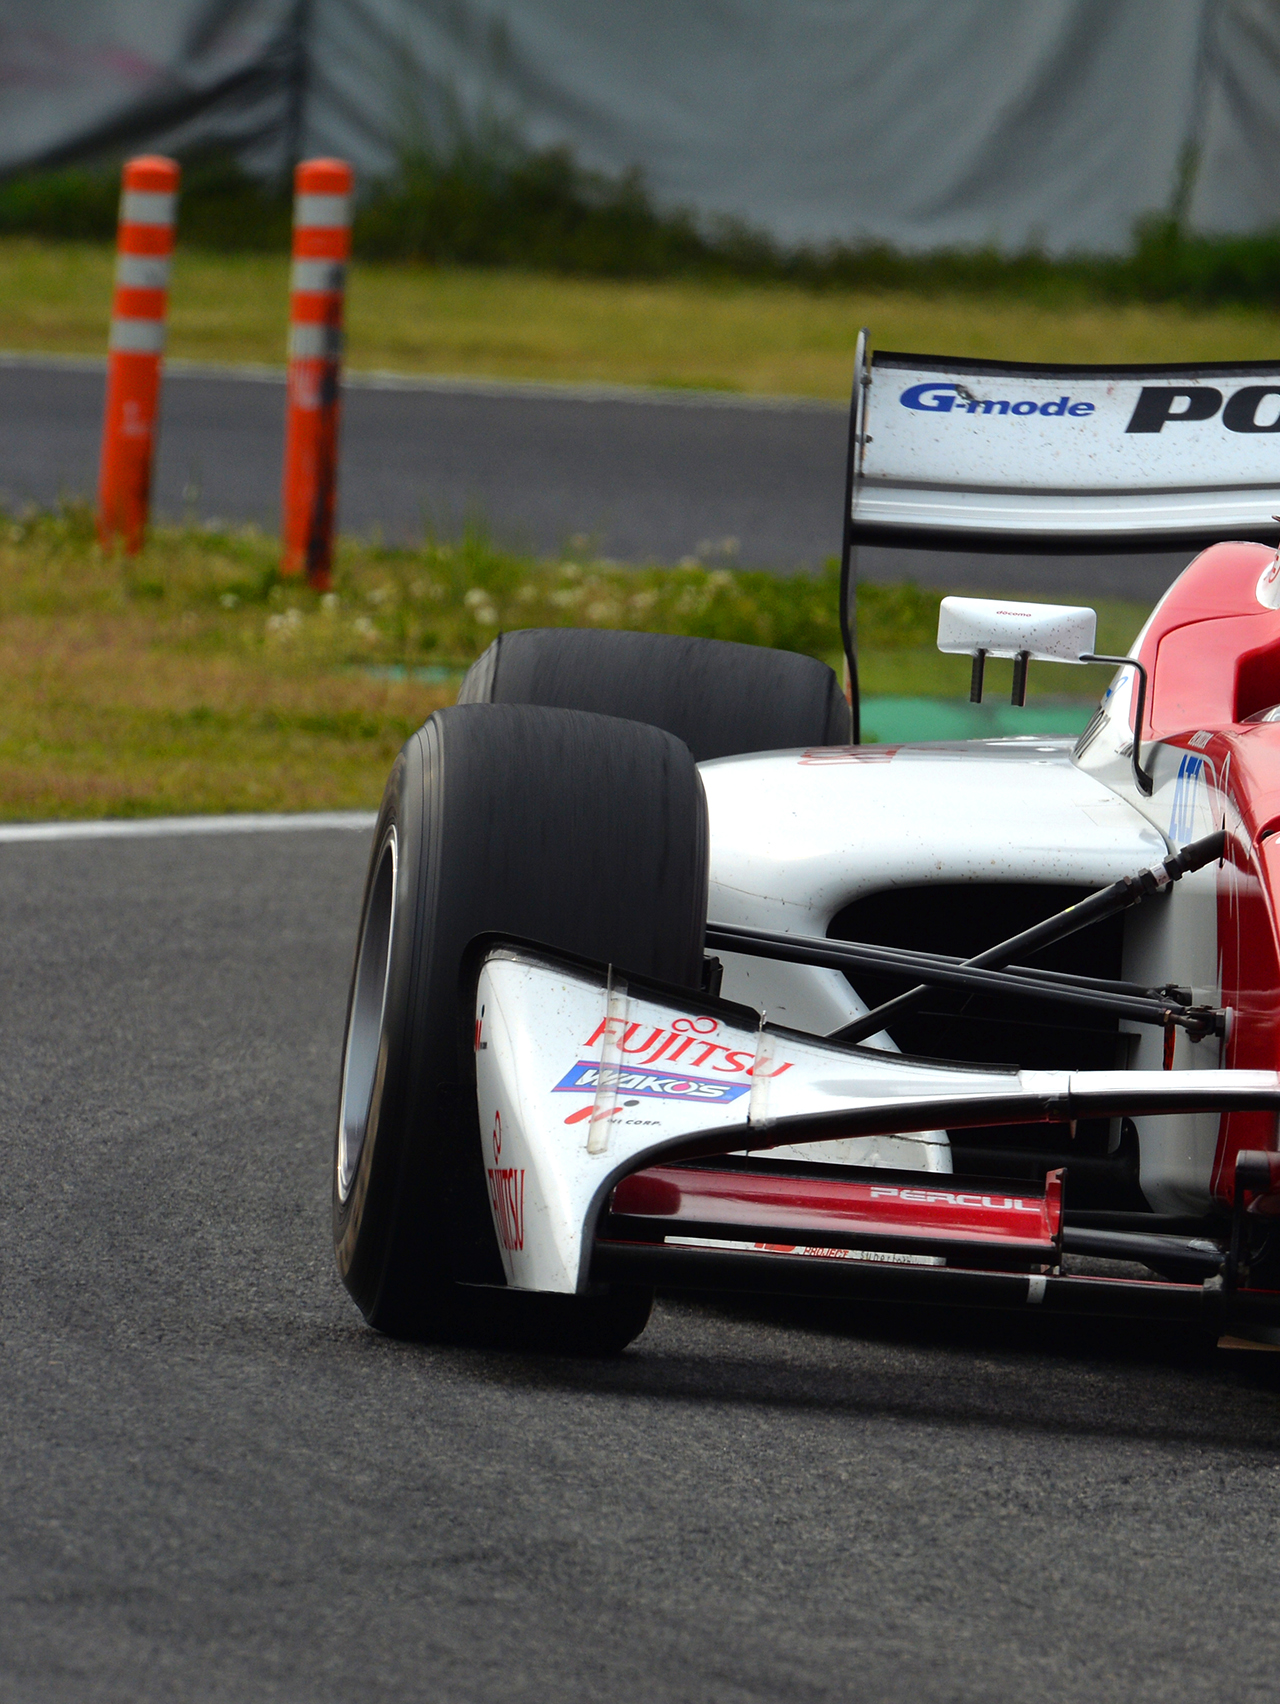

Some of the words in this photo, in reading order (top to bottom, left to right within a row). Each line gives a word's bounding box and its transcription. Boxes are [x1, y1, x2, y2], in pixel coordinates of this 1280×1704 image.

[900, 382, 1096, 418] G-mode
[996, 610, 1032, 618] docomo
[582, 1016, 796, 1079] FUJITSU
[870, 1186, 1041, 1213] PERCUL
[803, 1246, 849, 1259] PROJECT
